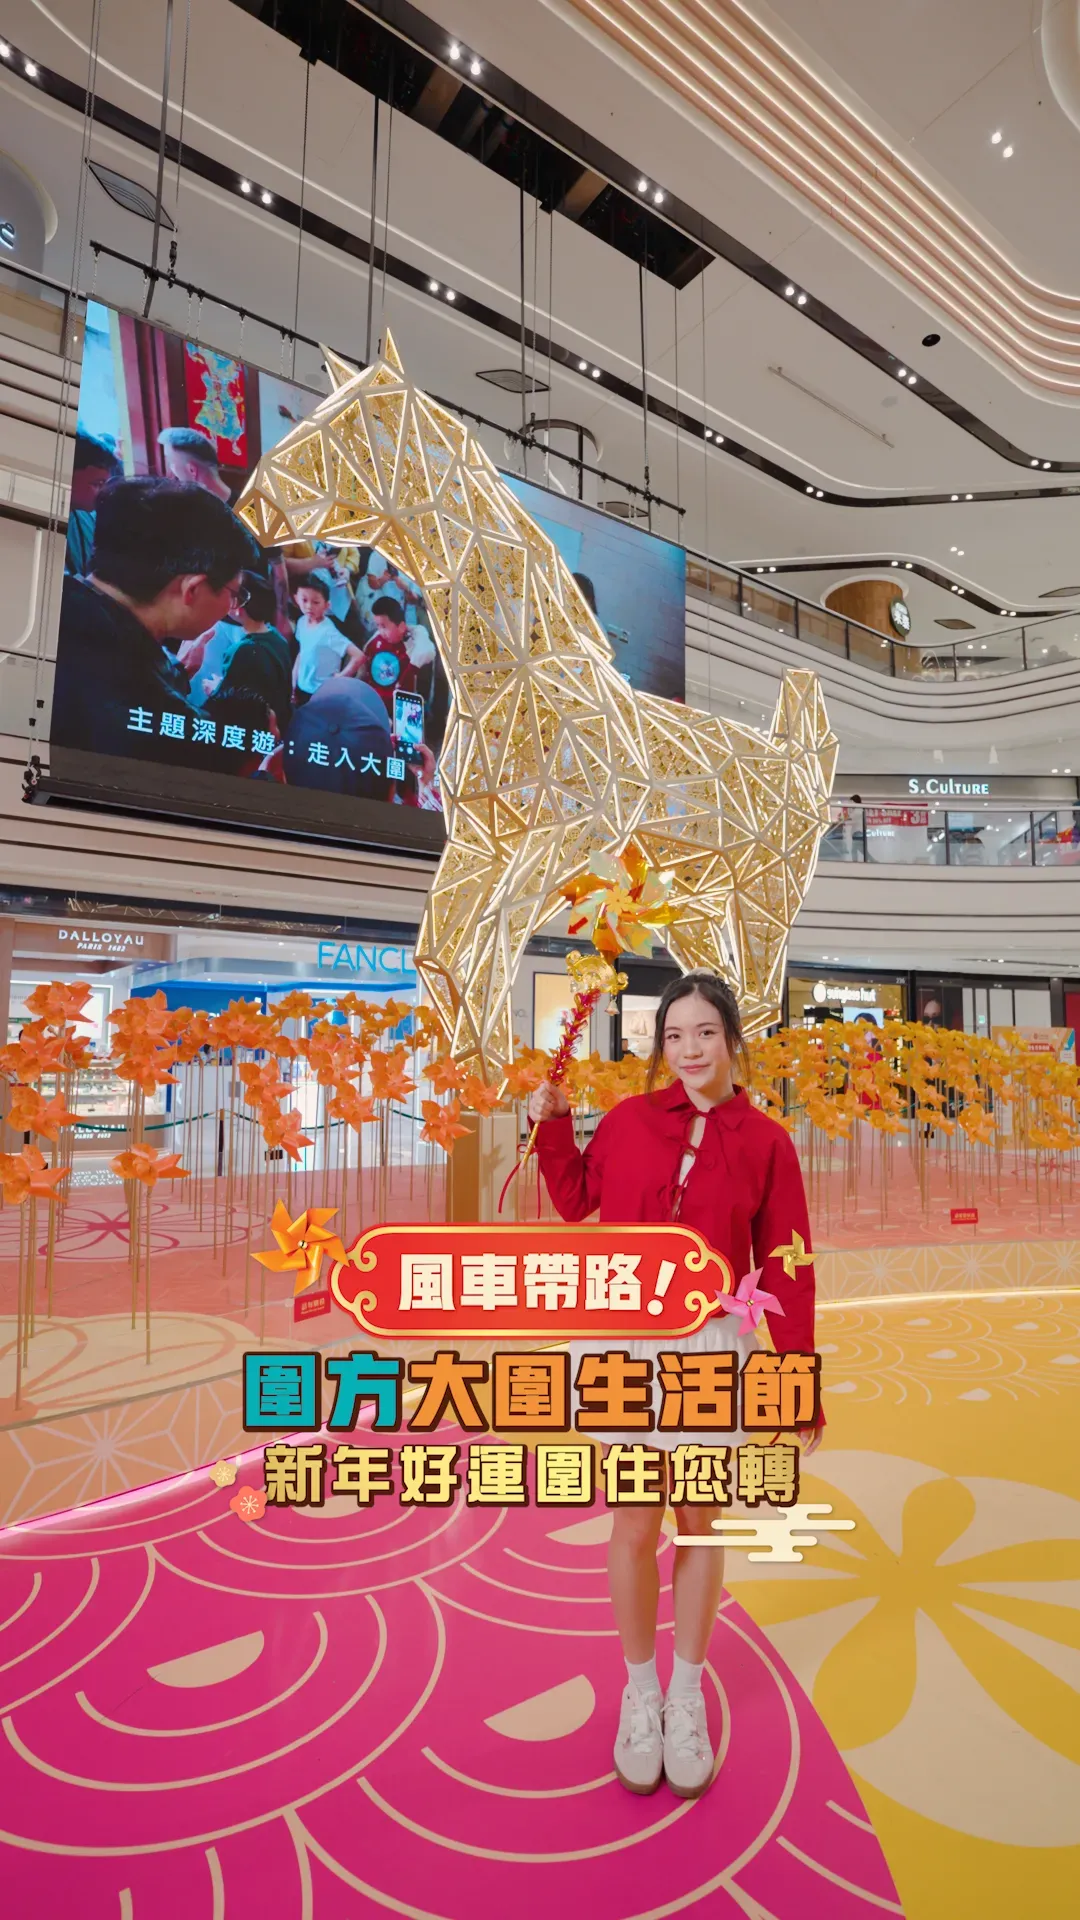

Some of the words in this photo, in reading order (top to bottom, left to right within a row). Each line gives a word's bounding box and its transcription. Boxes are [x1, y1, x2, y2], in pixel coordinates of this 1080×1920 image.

[58, 929, 144, 946] DALLOYAU
[76, 942, 102, 951] PARIS
[317, 941, 416, 975] FANCL
